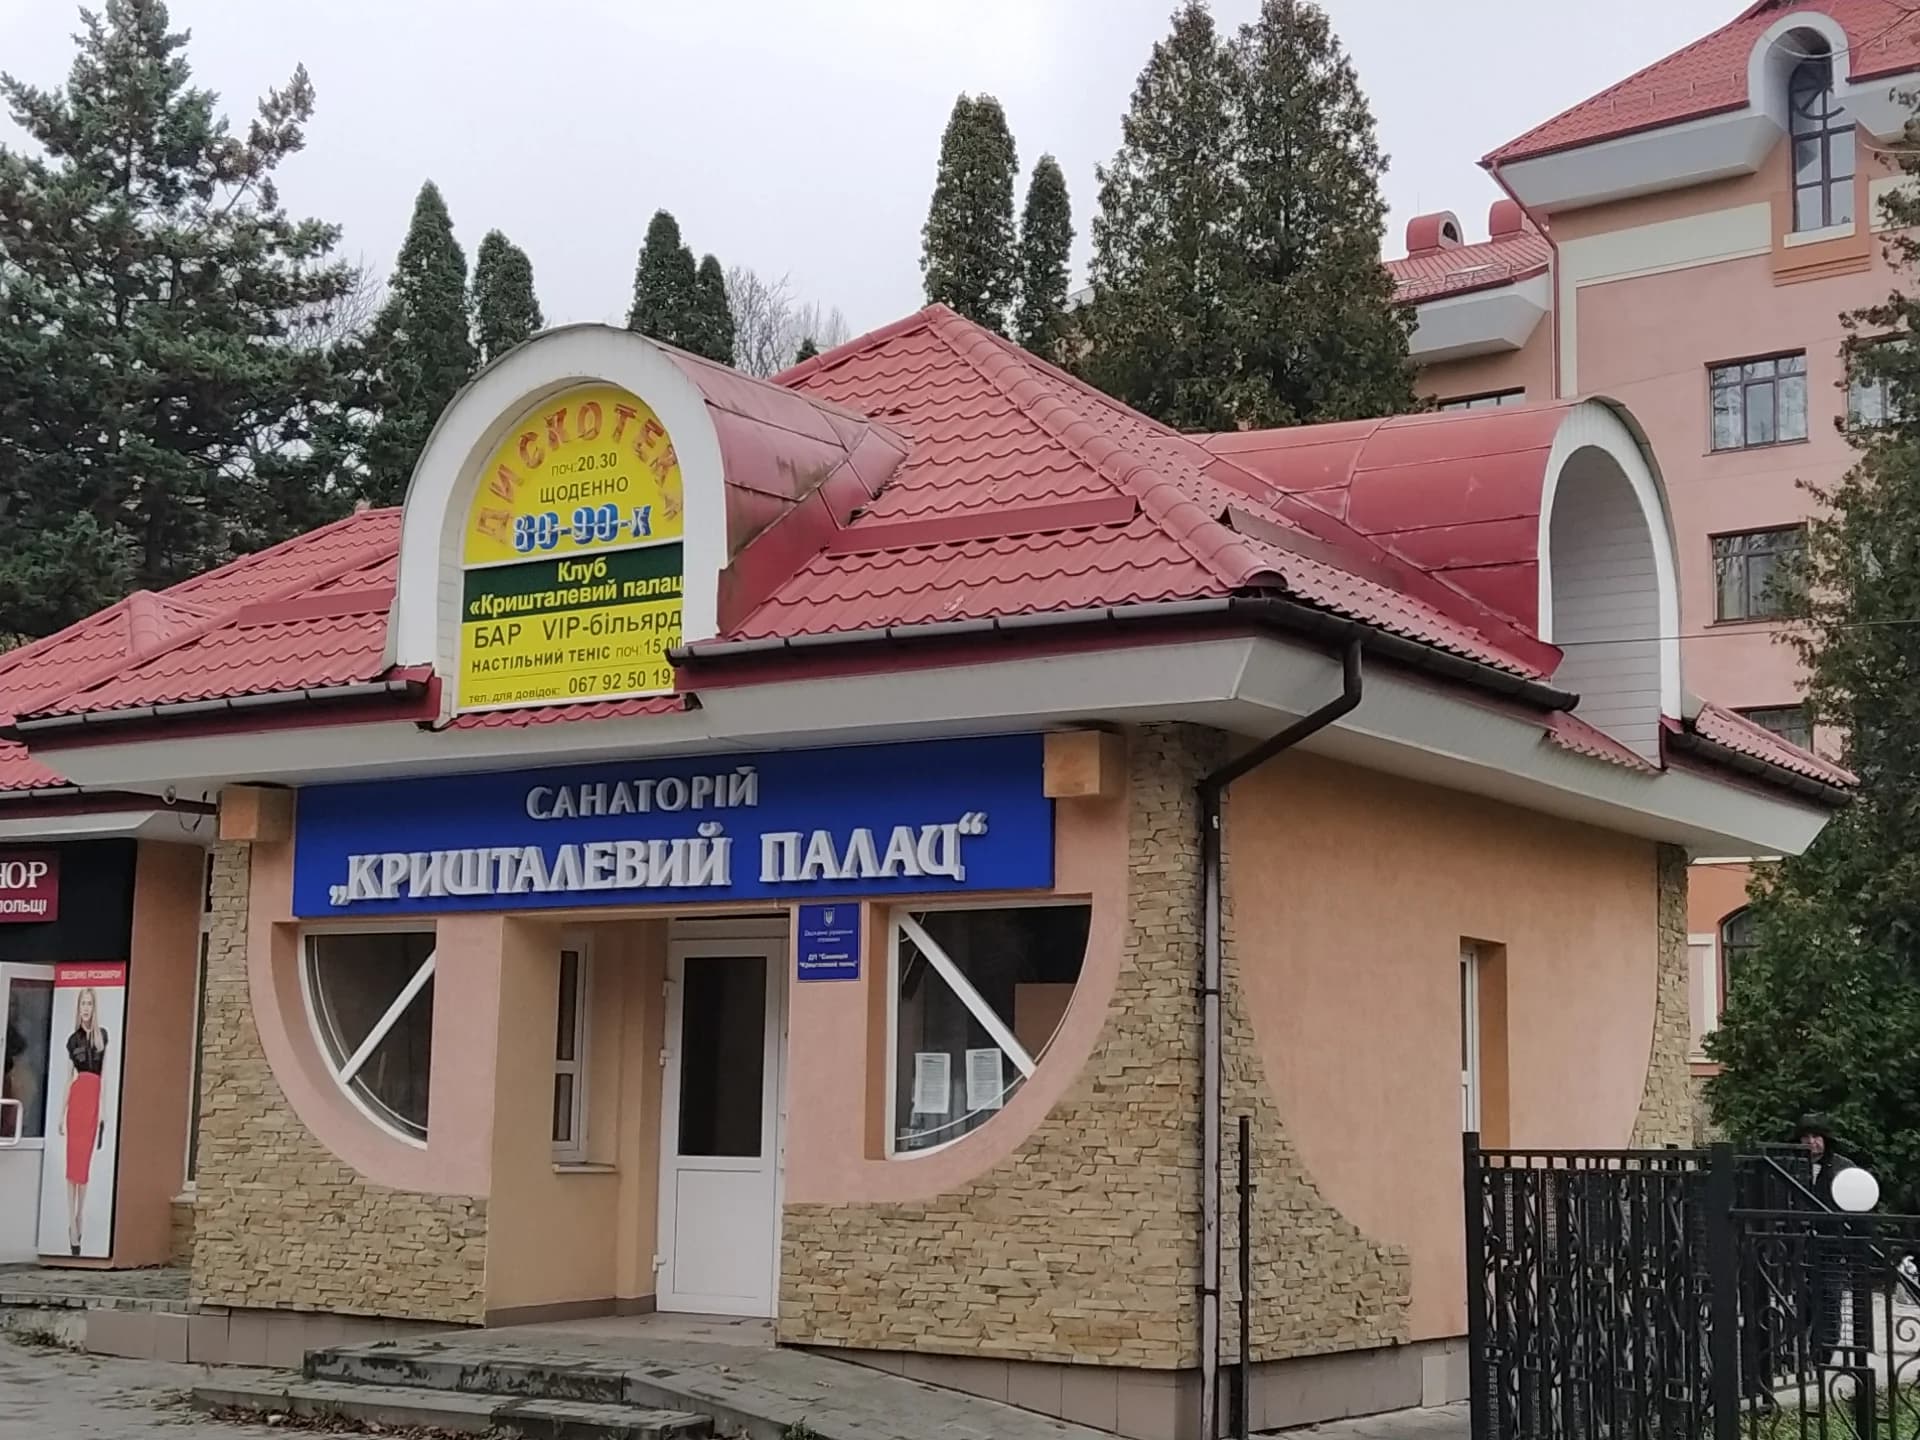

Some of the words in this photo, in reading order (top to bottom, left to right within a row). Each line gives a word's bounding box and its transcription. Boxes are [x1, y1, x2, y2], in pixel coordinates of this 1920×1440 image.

[540, 477, 629, 504] ЩОДЕННО
[558, 557, 609, 583] Клуб
[469, 579, 618, 618] «Кришталевий
[474, 623, 522, 649] БАР
[543, 610, 682, 644] VIP-більярд
[472, 649, 563, 674] НАСТІЛЬНИЙ
[570, 646, 611, 663] ТЕНІС
[492, 690, 512, 702] для
[569, 675, 597, 694] 067
[603, 673, 621, 691] 92
[627, 670, 646, 688] 50
[526, 766, 758, 820] САНАТОРІЙ
